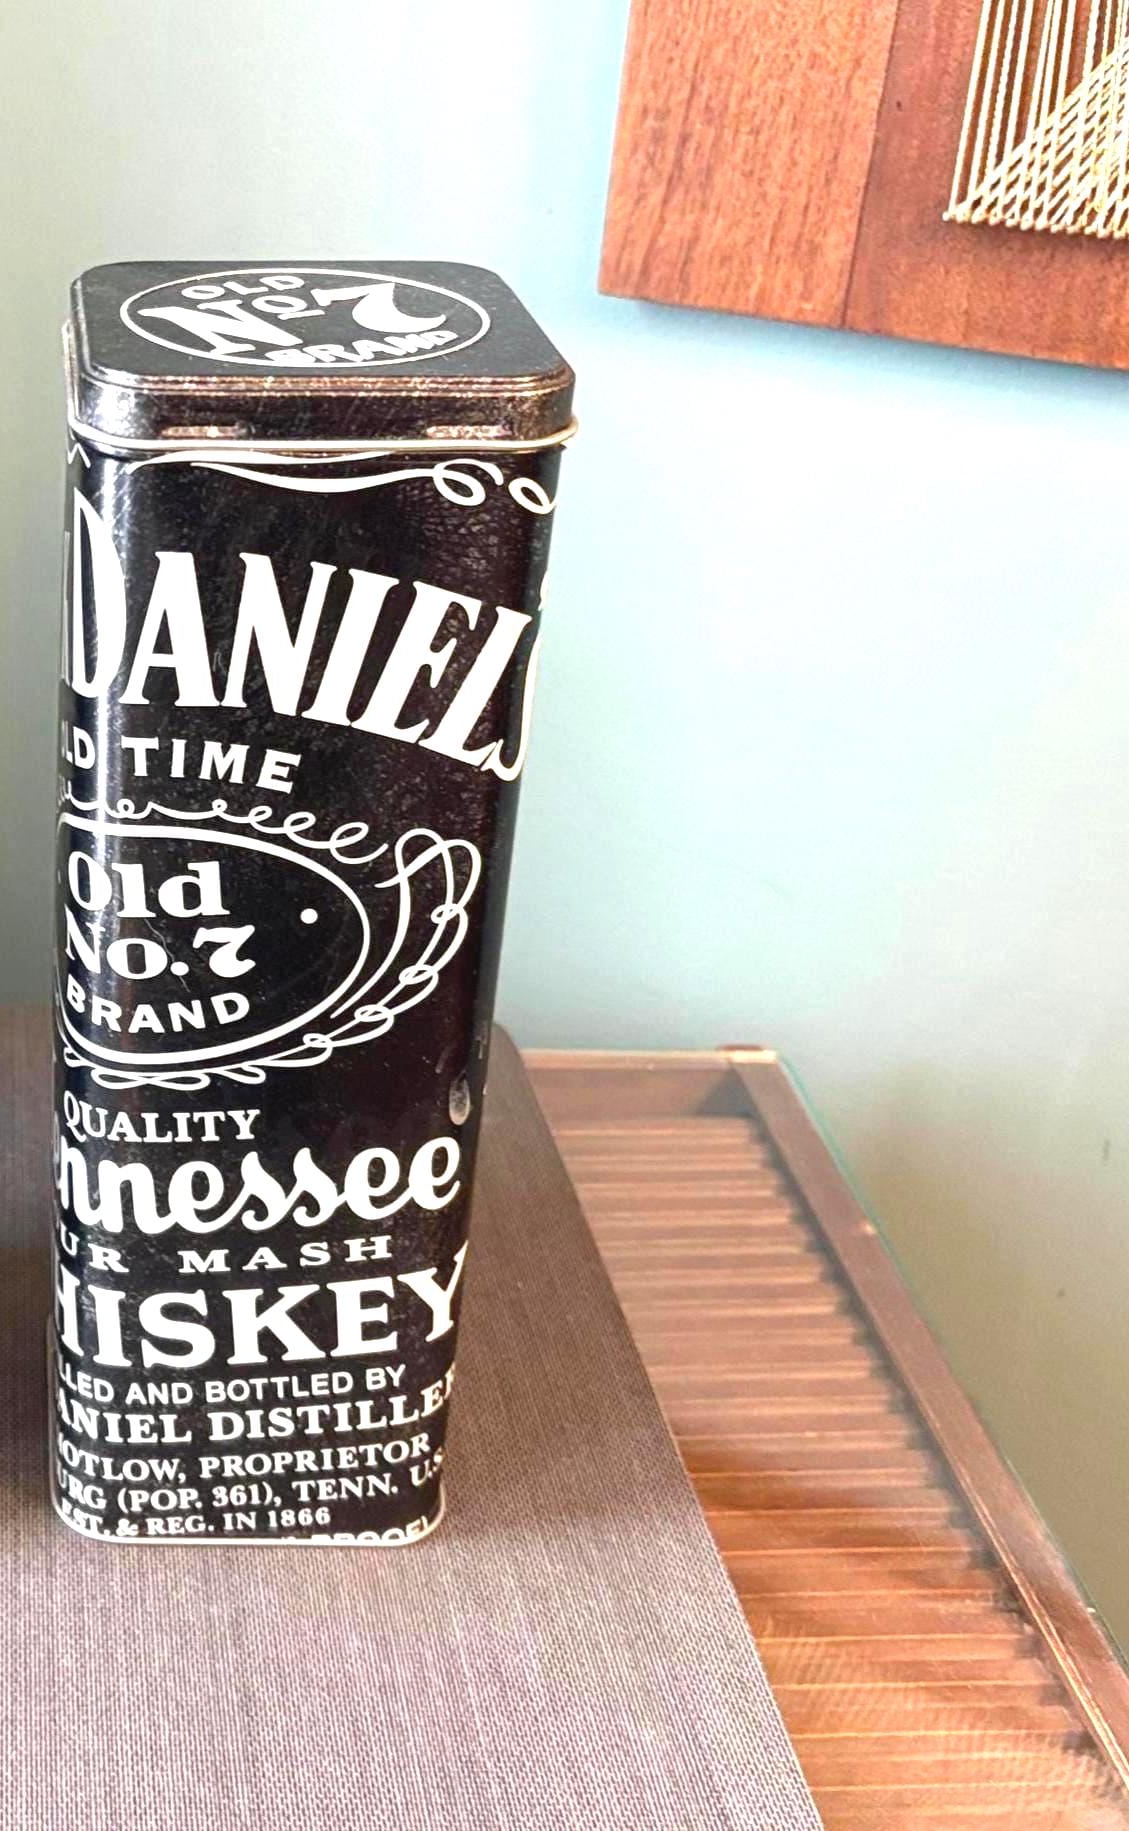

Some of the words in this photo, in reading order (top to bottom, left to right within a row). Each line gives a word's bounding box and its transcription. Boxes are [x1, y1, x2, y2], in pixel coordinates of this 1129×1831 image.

[181, 274, 305, 300] OLD
[265, 329, 458, 364] BRAND
[61, 721, 96, 770] LD
[121, 736, 302, 794] TIME
[68, 851, 230, 918] Old
[66, 973, 250, 1034] BRAND
[64, 1090, 260, 1143] QUALITY
[56, 1136, 461, 1234] nnessee
[59, 1220, 129, 1274] UR
[177, 1235, 392, 1274] MASH
[125, 1382, 193, 1405] AND
[204, 1371, 354, 1403] BOTTLED
[365, 1364, 406, 1390] BY
[58, 1432, 187, 1484] OTLOW,
[198, 1432, 431, 1479] PROPRIETOR
[117, 1488, 203, 1514] (POP.
[212, 1481, 282, 1508] 361),
[292, 1473, 398, 1503] TENN.
[116, 1518, 139, 1537] &
[146, 1514, 214, 1536] REG.
[223, 1511, 257, 1531] IN
[268, 1506, 331, 1528] 1866
